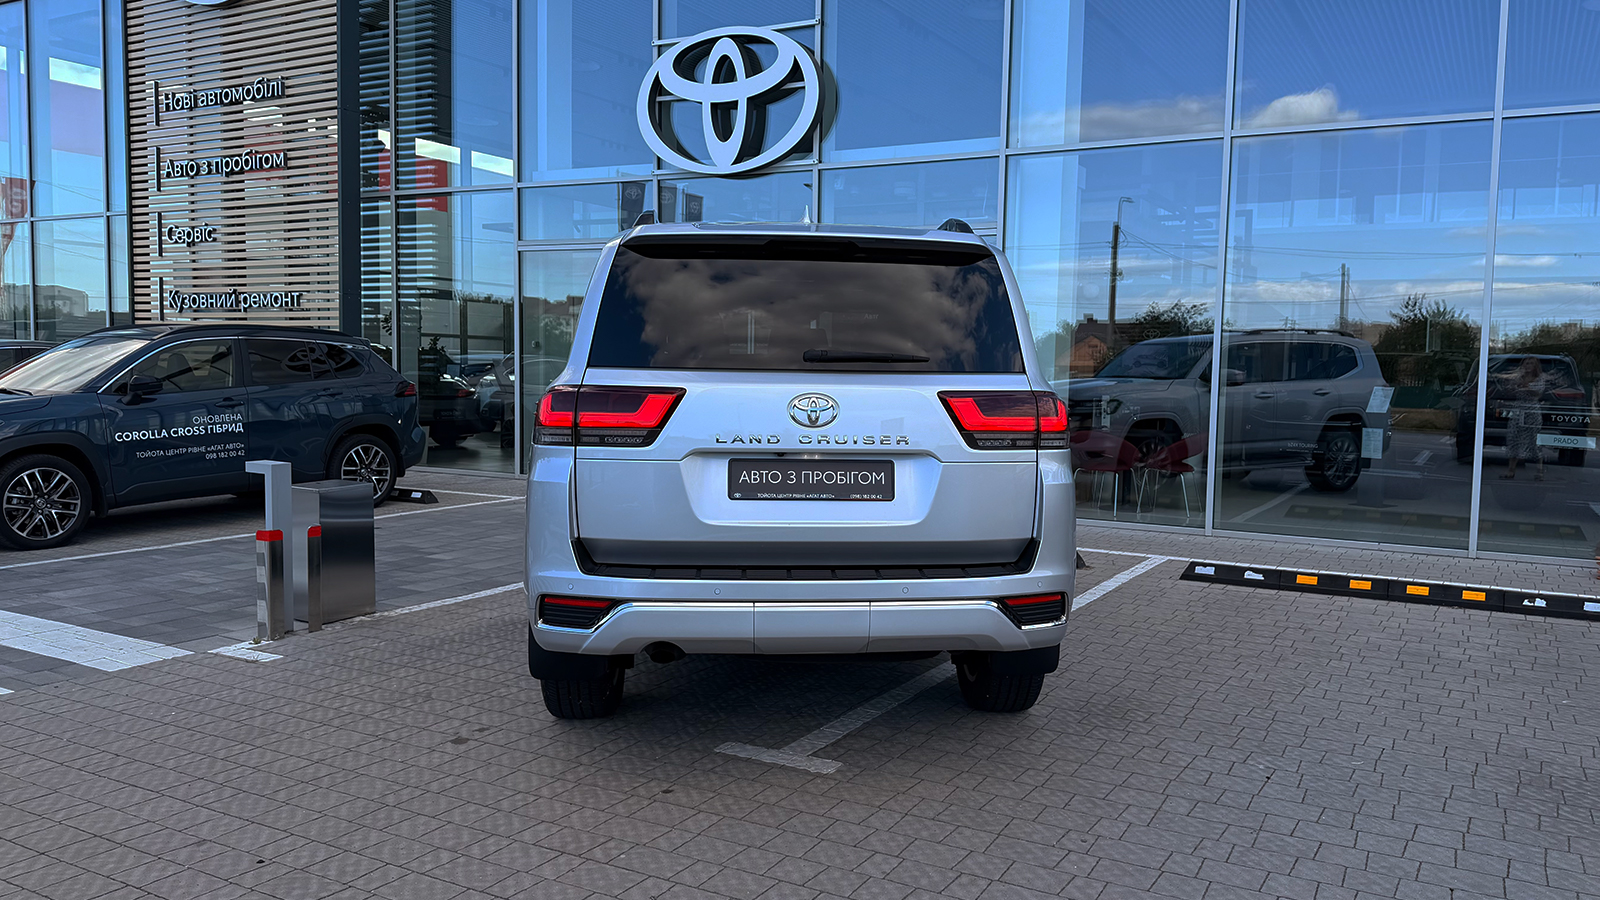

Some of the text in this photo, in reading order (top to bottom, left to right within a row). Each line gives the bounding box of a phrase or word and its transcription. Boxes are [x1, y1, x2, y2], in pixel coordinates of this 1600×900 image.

[163, 76, 283, 111] Нові автомобілі
[164, 149, 286, 177] Авто з пробігом
[166, 222, 214, 246] Сервіс
[167, 288, 301, 312] Кузовний ремонт
[192, 413, 243, 425] ОНОВЛЕНА
[1551, 415, 1590, 423] TOYOTA
[115, 422, 244, 442] COROLLA CROSS ГІБРИД
[715, 433, 910, 445] LAND CRUISER
[1553, 437, 1579, 445] PRADO
[136, 449, 164, 458] ТОЙОТА
[165, 447, 187, 456] ЦЕНТР
[187, 445, 206, 453] РІВНЕ
[739, 470, 885, 485] АВТО З ПРОБІГОМ
